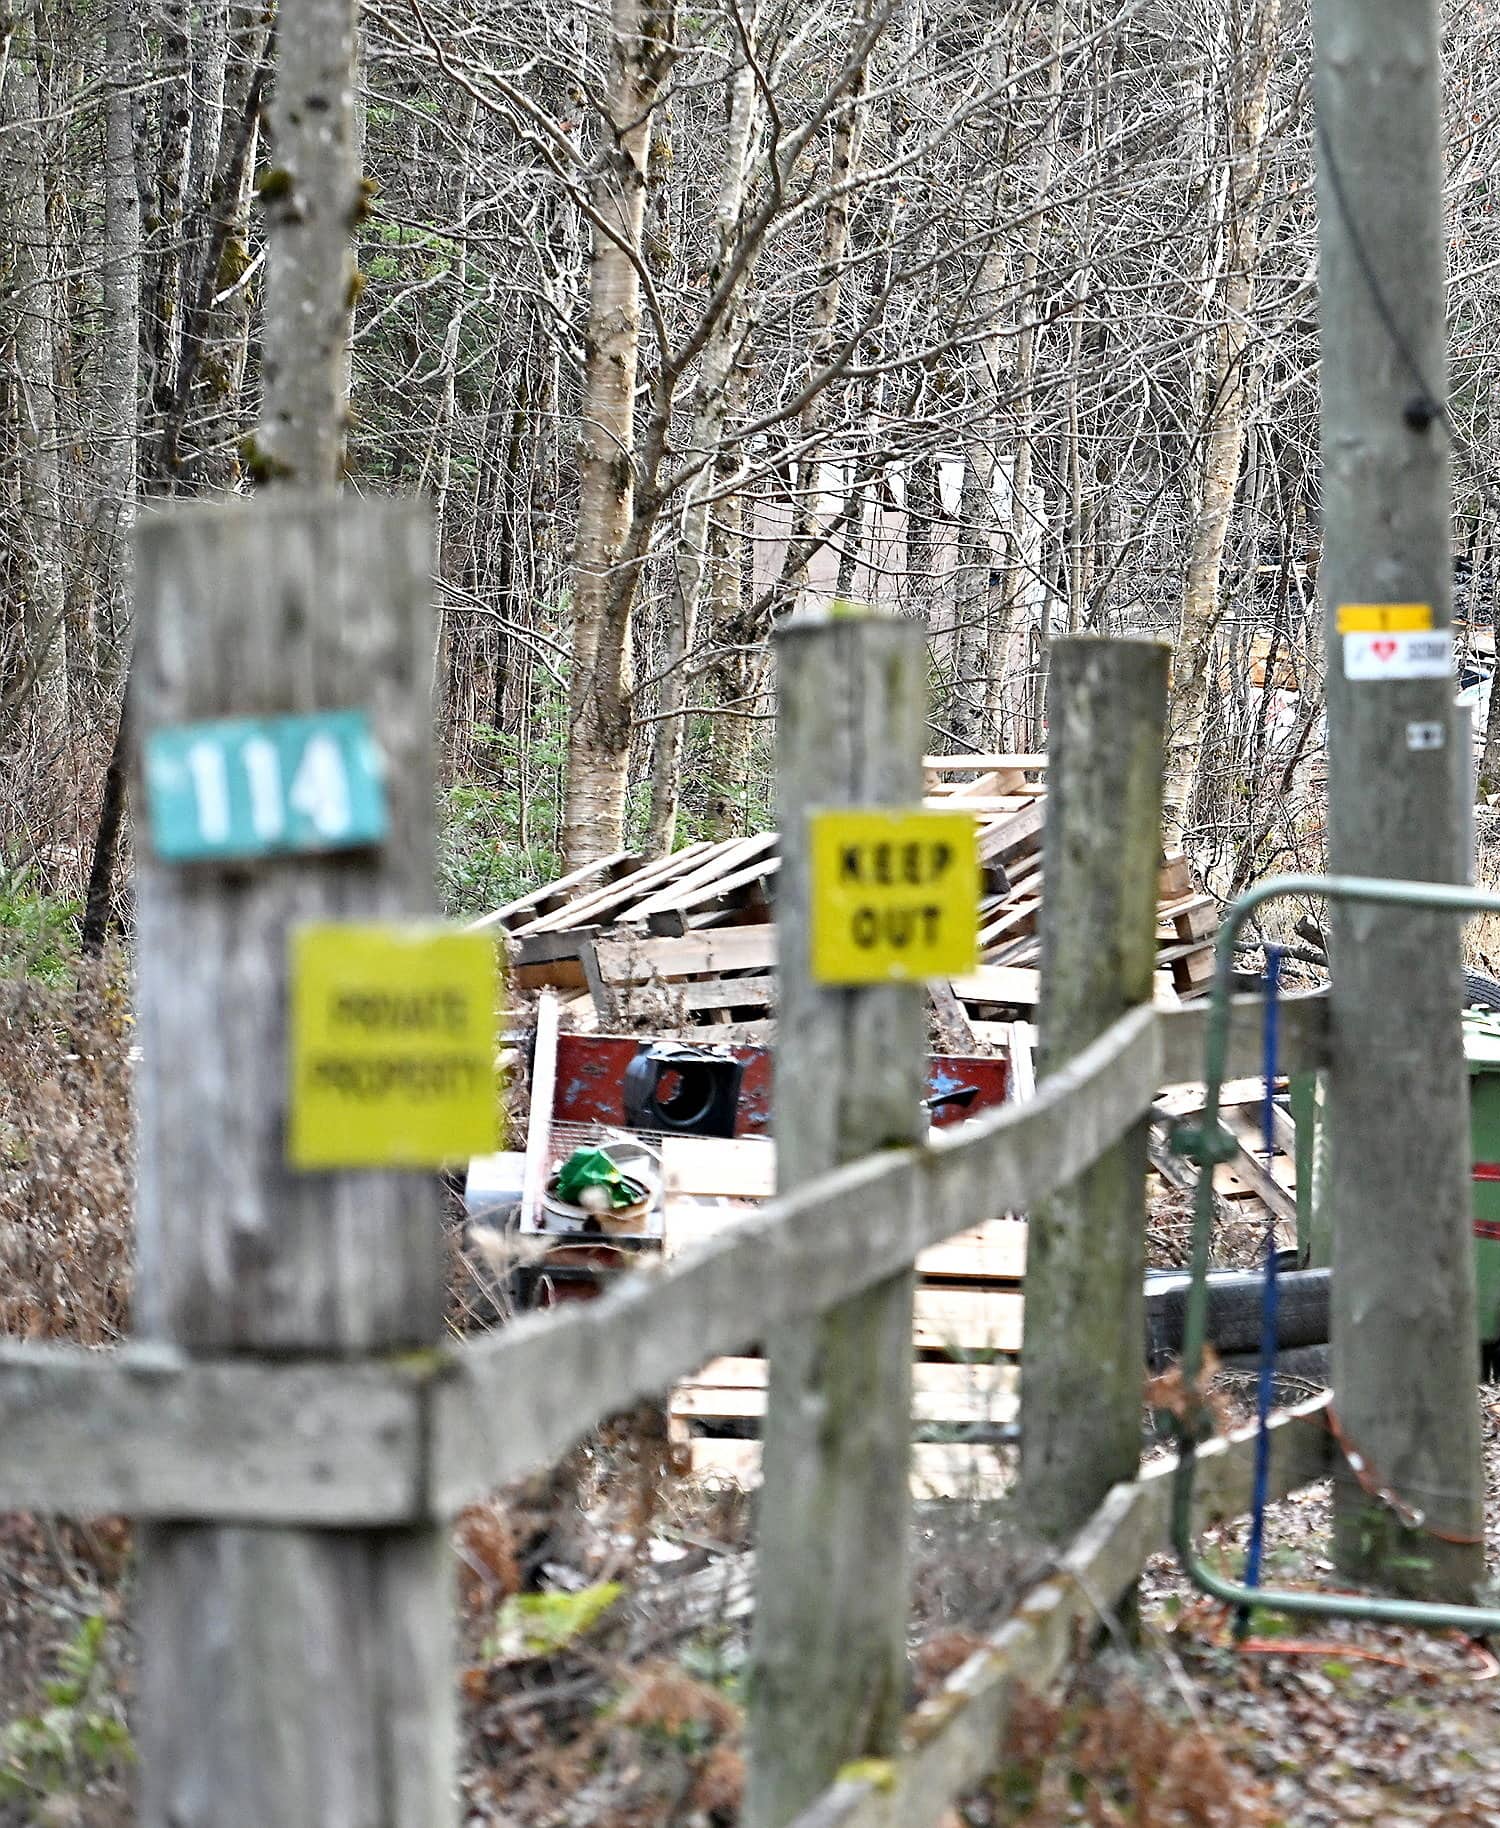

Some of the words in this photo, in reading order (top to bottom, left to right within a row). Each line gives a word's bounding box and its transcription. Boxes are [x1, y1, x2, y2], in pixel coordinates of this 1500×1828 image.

[188, 735, 353, 843] 114
[840, 842, 952, 886] KEEP
[852, 906, 941, 949] OUT
[333, 987, 469, 1031] PRIVATE
[313, 1053, 481, 1102] PROPERTY
